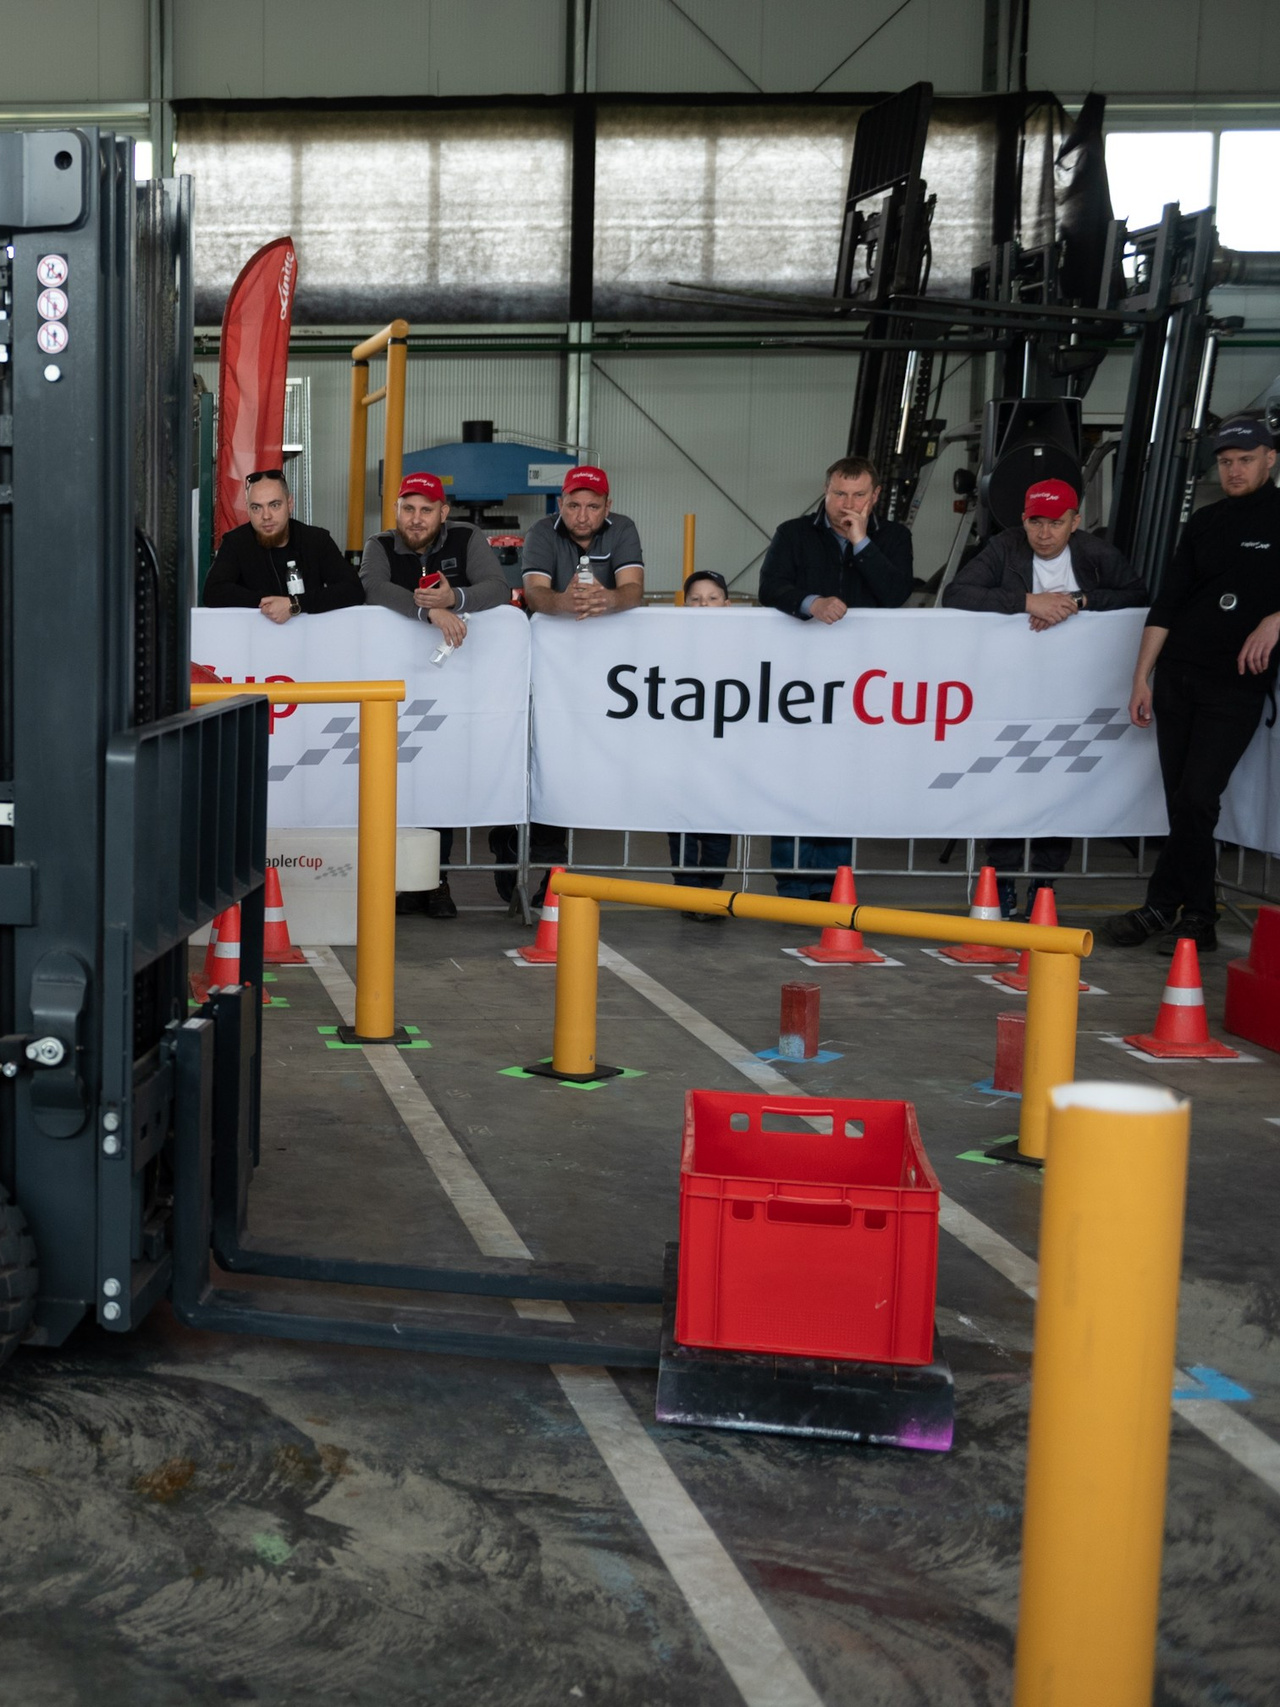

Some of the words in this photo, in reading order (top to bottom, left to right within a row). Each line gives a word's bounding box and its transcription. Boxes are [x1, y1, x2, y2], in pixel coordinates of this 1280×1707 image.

[1180, 476, 1195, 523] STILL
[606, 661, 974, 741] StaplerCup
[265, 854, 323, 870] aplerCup
